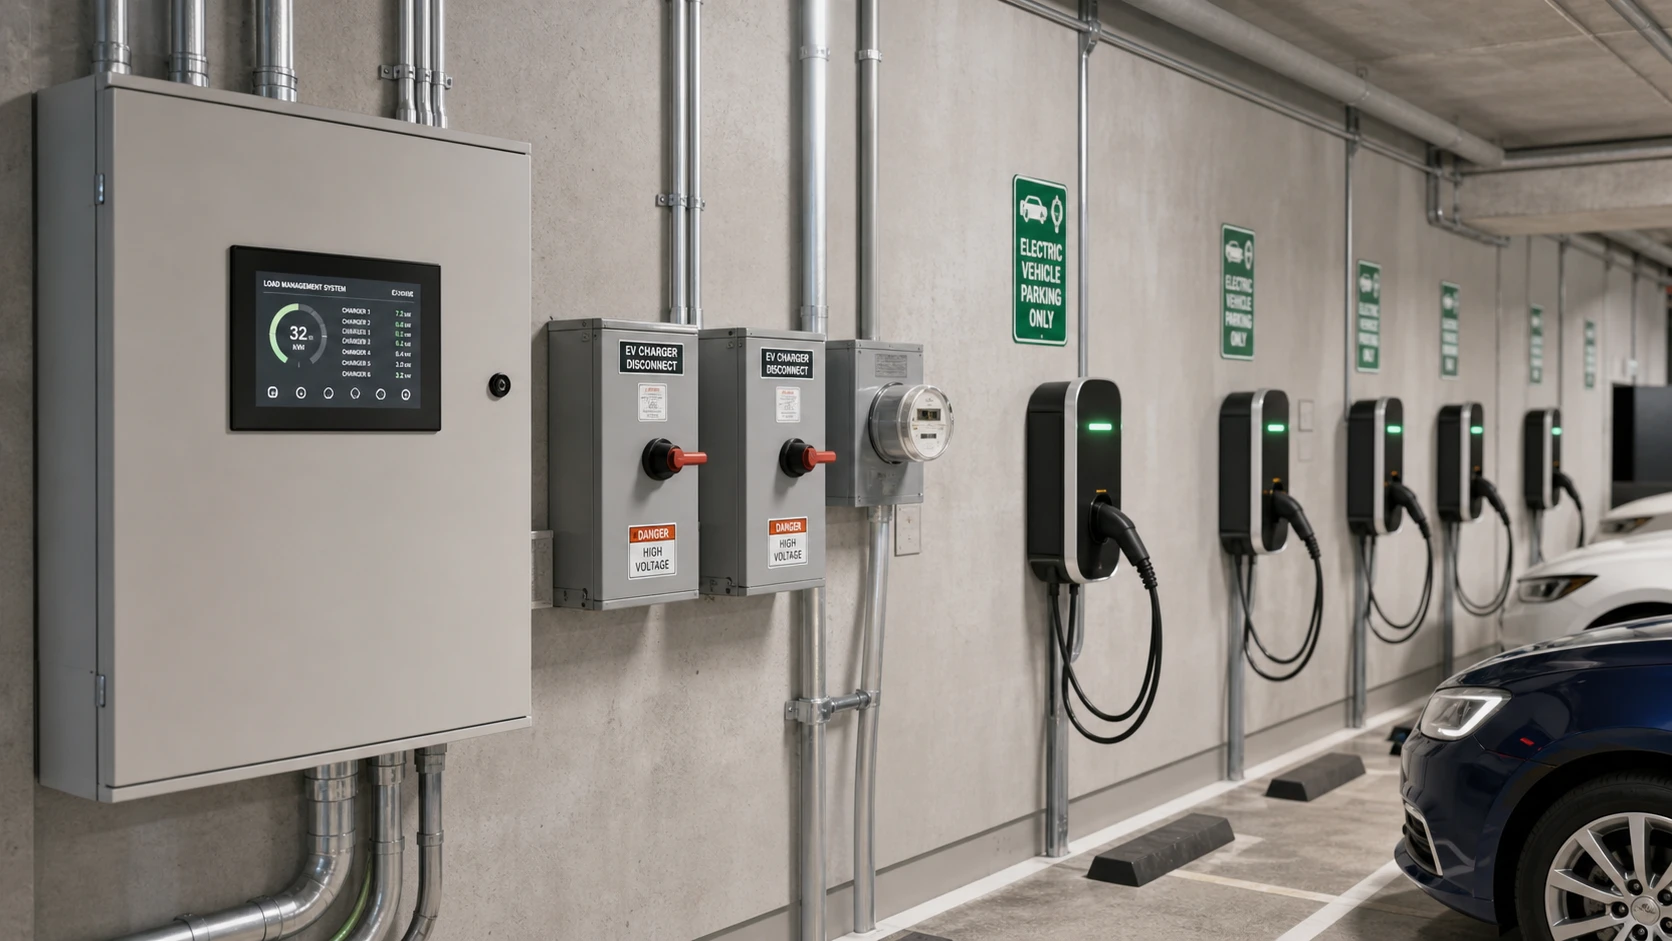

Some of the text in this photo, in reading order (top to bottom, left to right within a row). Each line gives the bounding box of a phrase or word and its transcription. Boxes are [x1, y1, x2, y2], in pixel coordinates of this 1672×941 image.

[1020, 238, 1062, 261] ELECTRIC
[1022, 261, 1060, 283] VEHICLE
[282, 282, 322, 290] MANAGEMENT
[1021, 284, 1062, 306] PARKING
[1029, 308, 1054, 329] ONLY
[290, 326, 307, 340] 32
[626, 346, 677, 357] EV CHARGER
[766, 352, 809, 363] EV CHARGER
[627, 360, 677, 370] DISCONNECT
[767, 365, 808, 375] DISCONNECT
[776, 522, 801, 532] DANGER
[638, 528, 669, 540] DANGER
[780, 539, 796, 548] HIGH
[643, 547, 662, 557] HIGH
[636, 559, 669, 572] VOLTAGE
